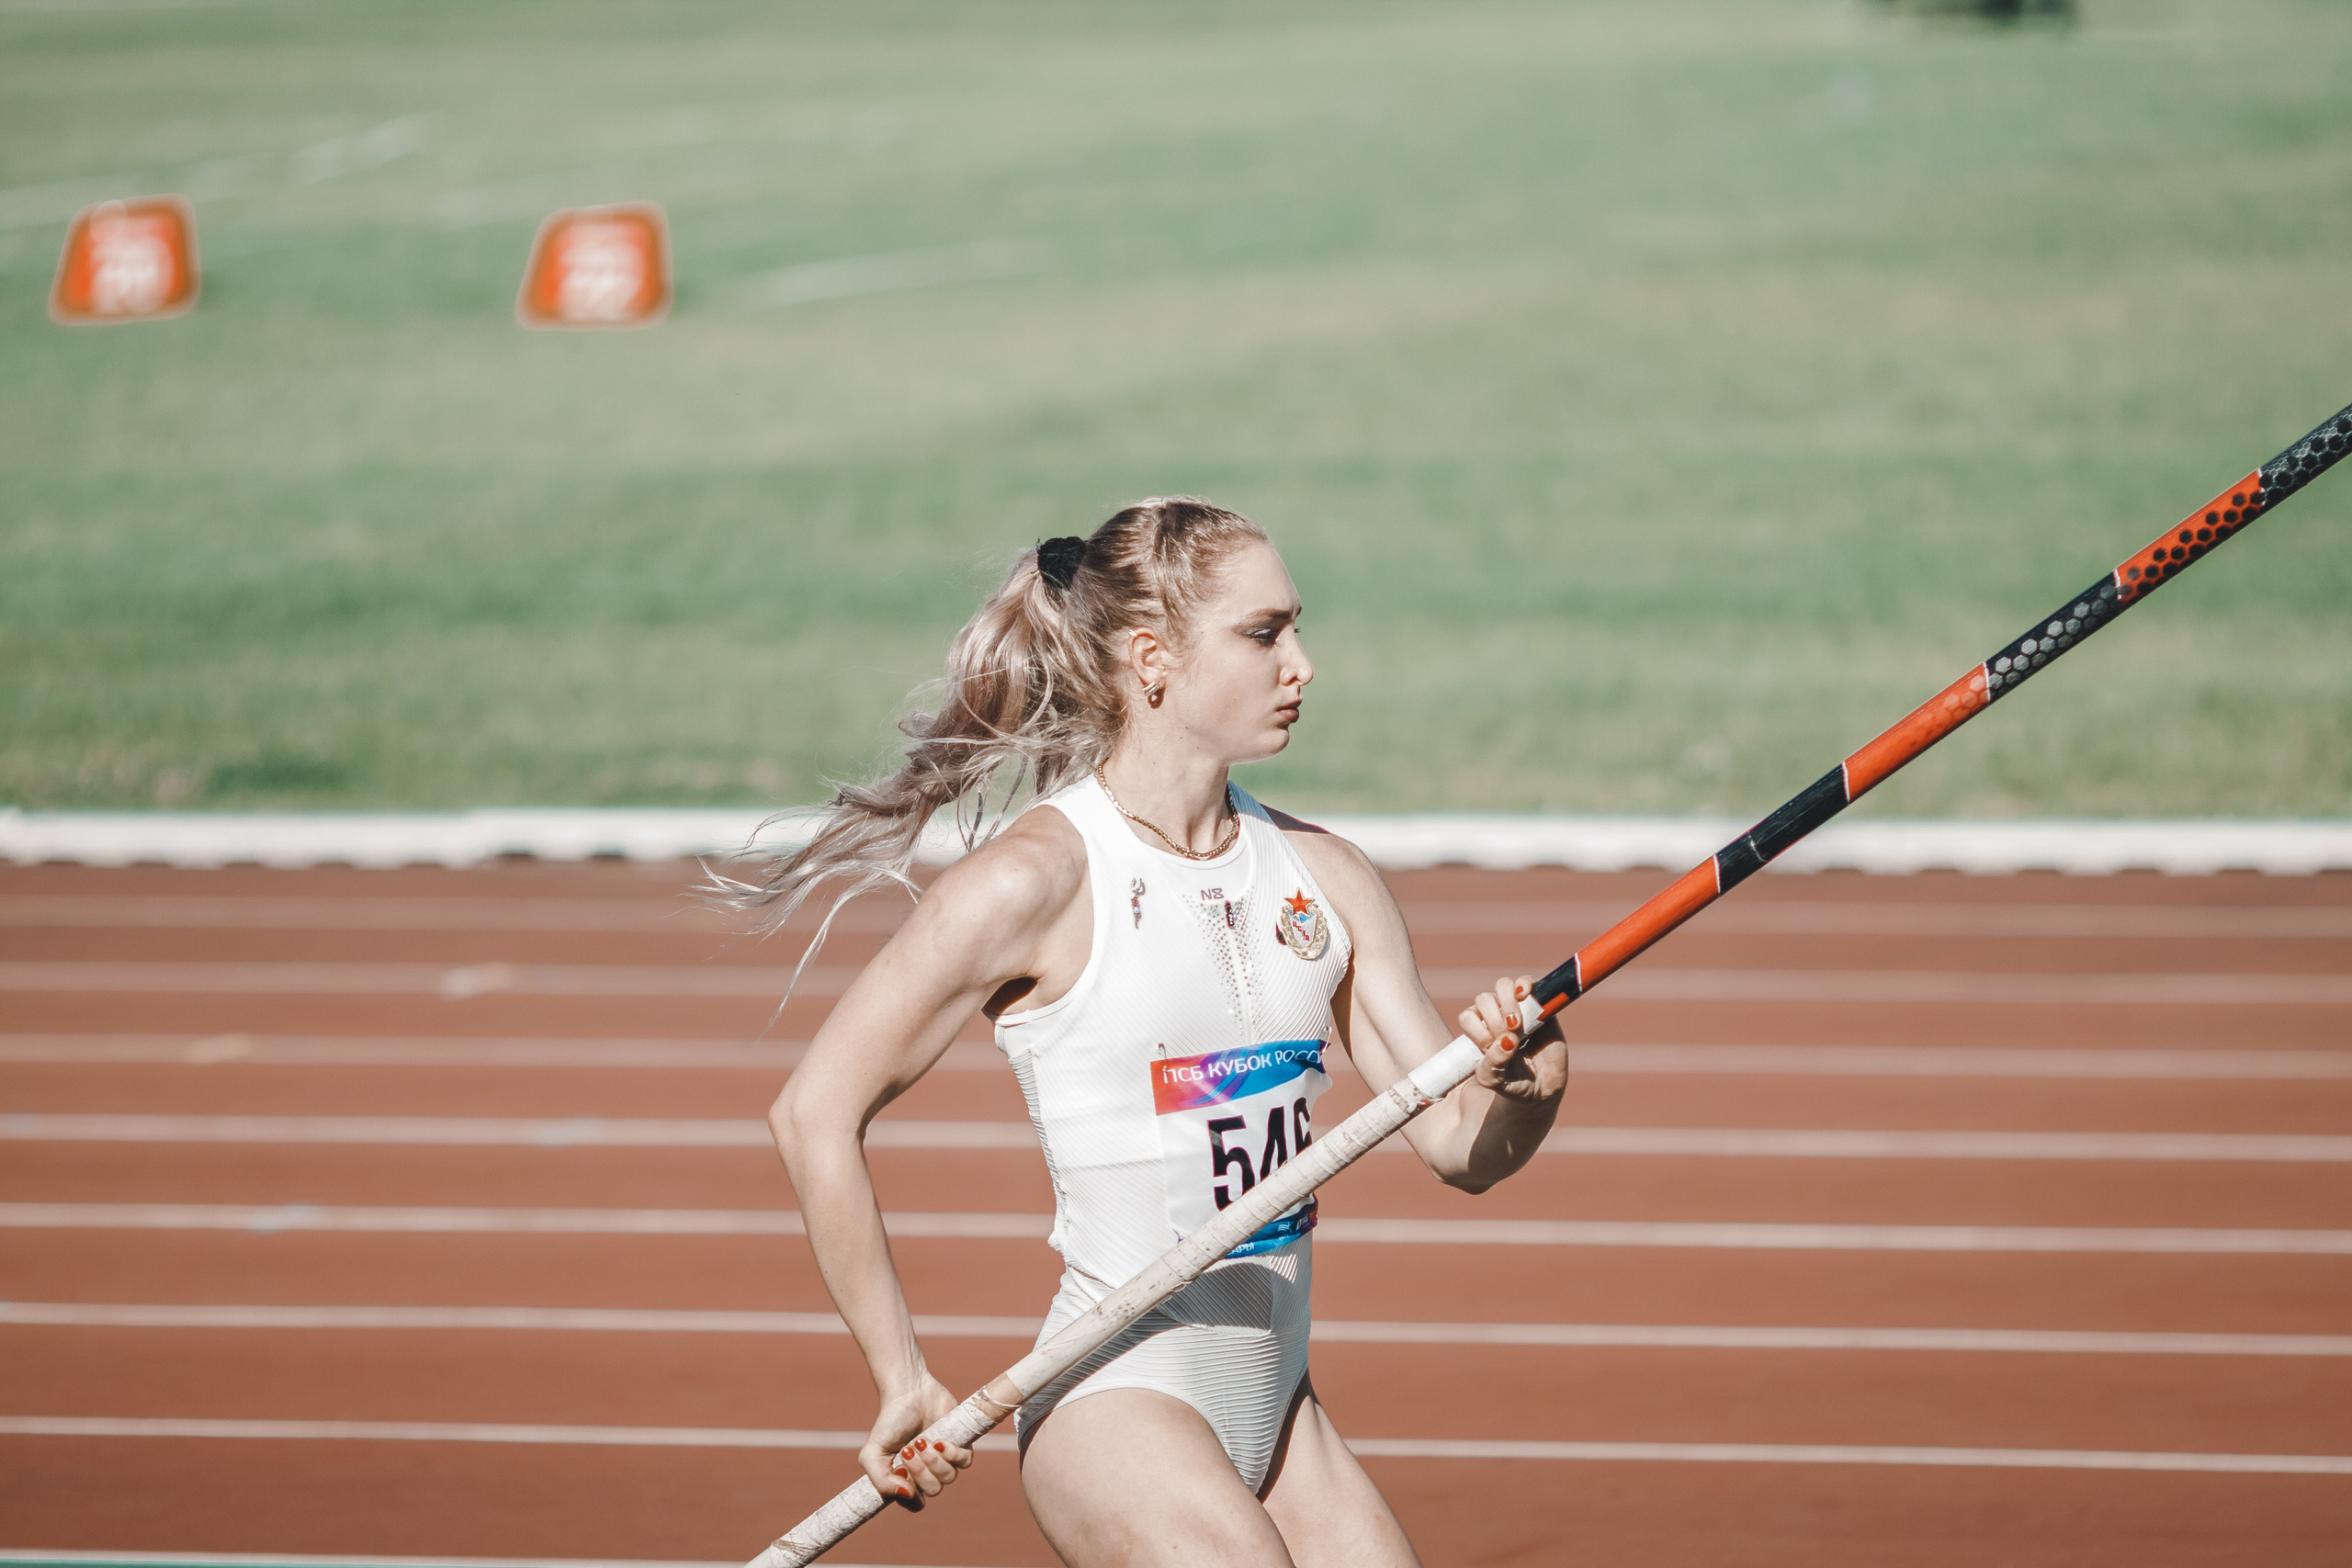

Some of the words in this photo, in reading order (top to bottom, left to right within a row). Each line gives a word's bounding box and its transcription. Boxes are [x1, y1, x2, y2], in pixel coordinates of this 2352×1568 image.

[1163, 1065, 1204, 1084] ПСБ
[1208, 1053, 1272, 1077] КУБОК
[1227, 1242, 1255, 1256] АРЫ
